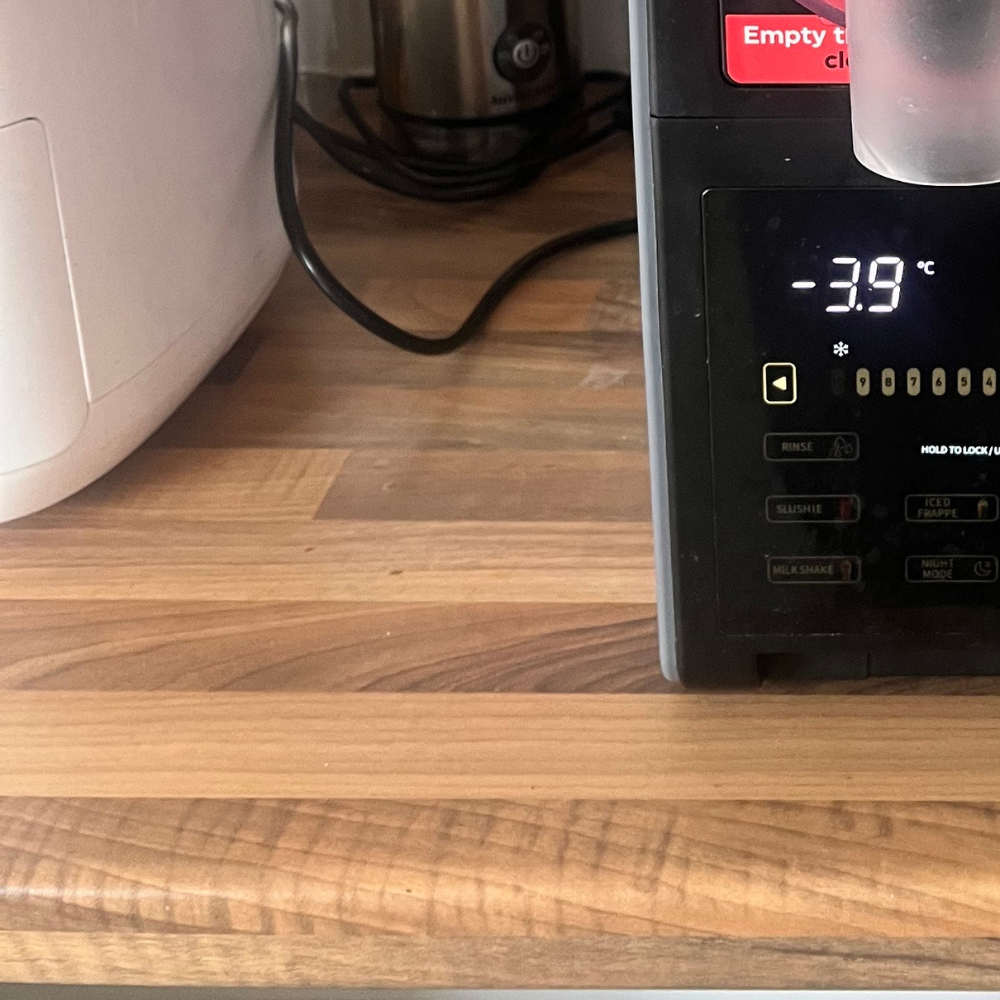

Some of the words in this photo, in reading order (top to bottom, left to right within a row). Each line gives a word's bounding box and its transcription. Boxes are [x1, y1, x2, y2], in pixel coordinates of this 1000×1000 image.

[743, 25, 827, 49] Empty
[791, 256, 905, 314] -3.9
[915, 259, 936, 276] °C
[859, 377, 867, 387] 9
[884, 377, 893, 387] 8
[909, 377, 918, 387] 7
[935, 377, 943, 387] 6
[960, 377, 968, 387] 5
[985, 377, 994, 387] 4
[781, 442, 814, 452] RINSE
[921, 445, 948, 454] HOLD
[948, 445, 962, 455] TO
[963, 446, 988, 455] LOCK
[924, 497, 951, 507] ICED
[776, 504, 822, 514] SLUSHIE
[922, 569, 953, 579] MODE
